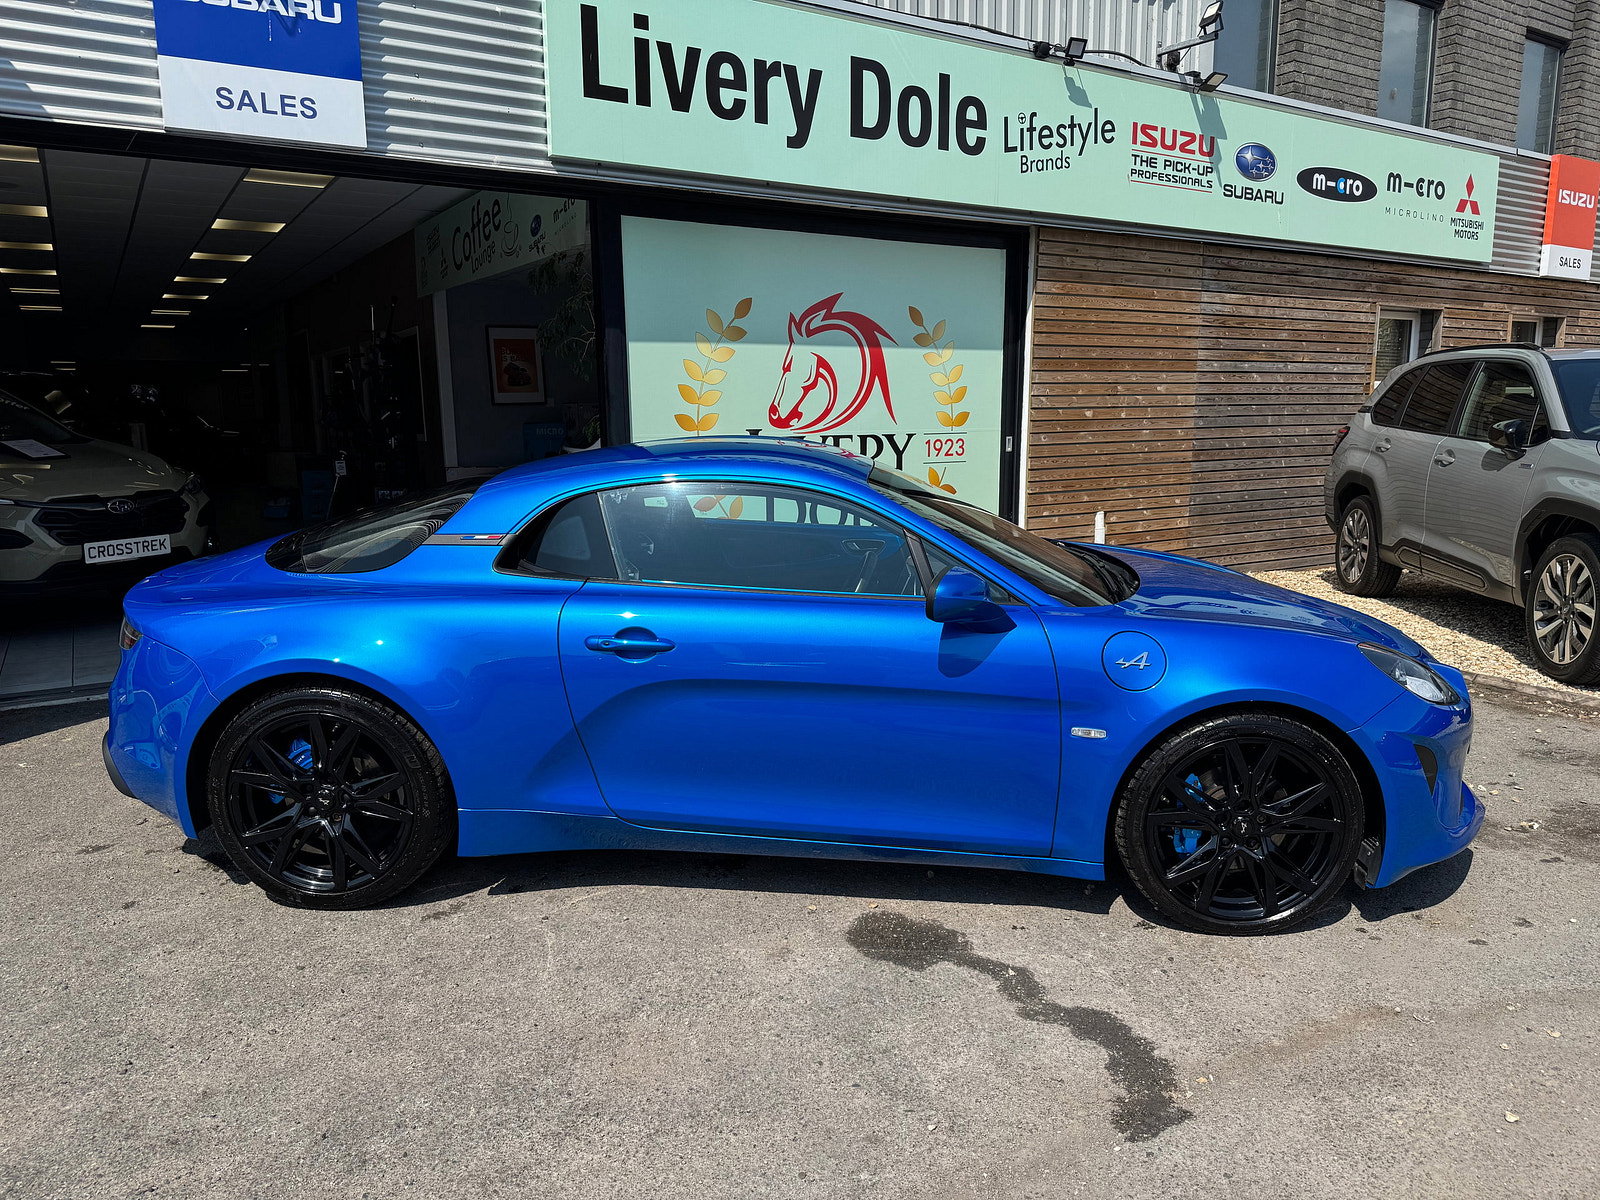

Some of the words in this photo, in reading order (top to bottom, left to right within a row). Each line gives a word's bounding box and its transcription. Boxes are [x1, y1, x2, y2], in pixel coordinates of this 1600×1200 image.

[579, 3, 823, 150] Livery
[850, 55, 988, 157] Dole
[215, 86, 318, 120] SALES
[1003, 107, 1116, 157] Lifestyle
[1131, 121, 1215, 158] ISUZU
[1019, 150, 1071, 174] Brands
[1131, 153, 1158, 169] THE
[1163, 158, 1214, 177] PICK-UP
[1130, 168, 1213, 189] PROFESSIONALS
[1222, 183, 1285, 206] SUBARU
[1558, 188, 1595, 209] ISUZU
[1384, 206, 1445, 223] MICROLINO
[1450, 217, 1485, 231] MITSUBISHI
[452, 198, 502, 271] Coffee
[1454, 229, 1479, 241] MOTORS
[471, 240, 497, 275] Lounge
[1558, 255, 1582, 270] SALES
[924, 437, 966, 458] 1923
[87, 537, 168, 560] CROSSTREK
